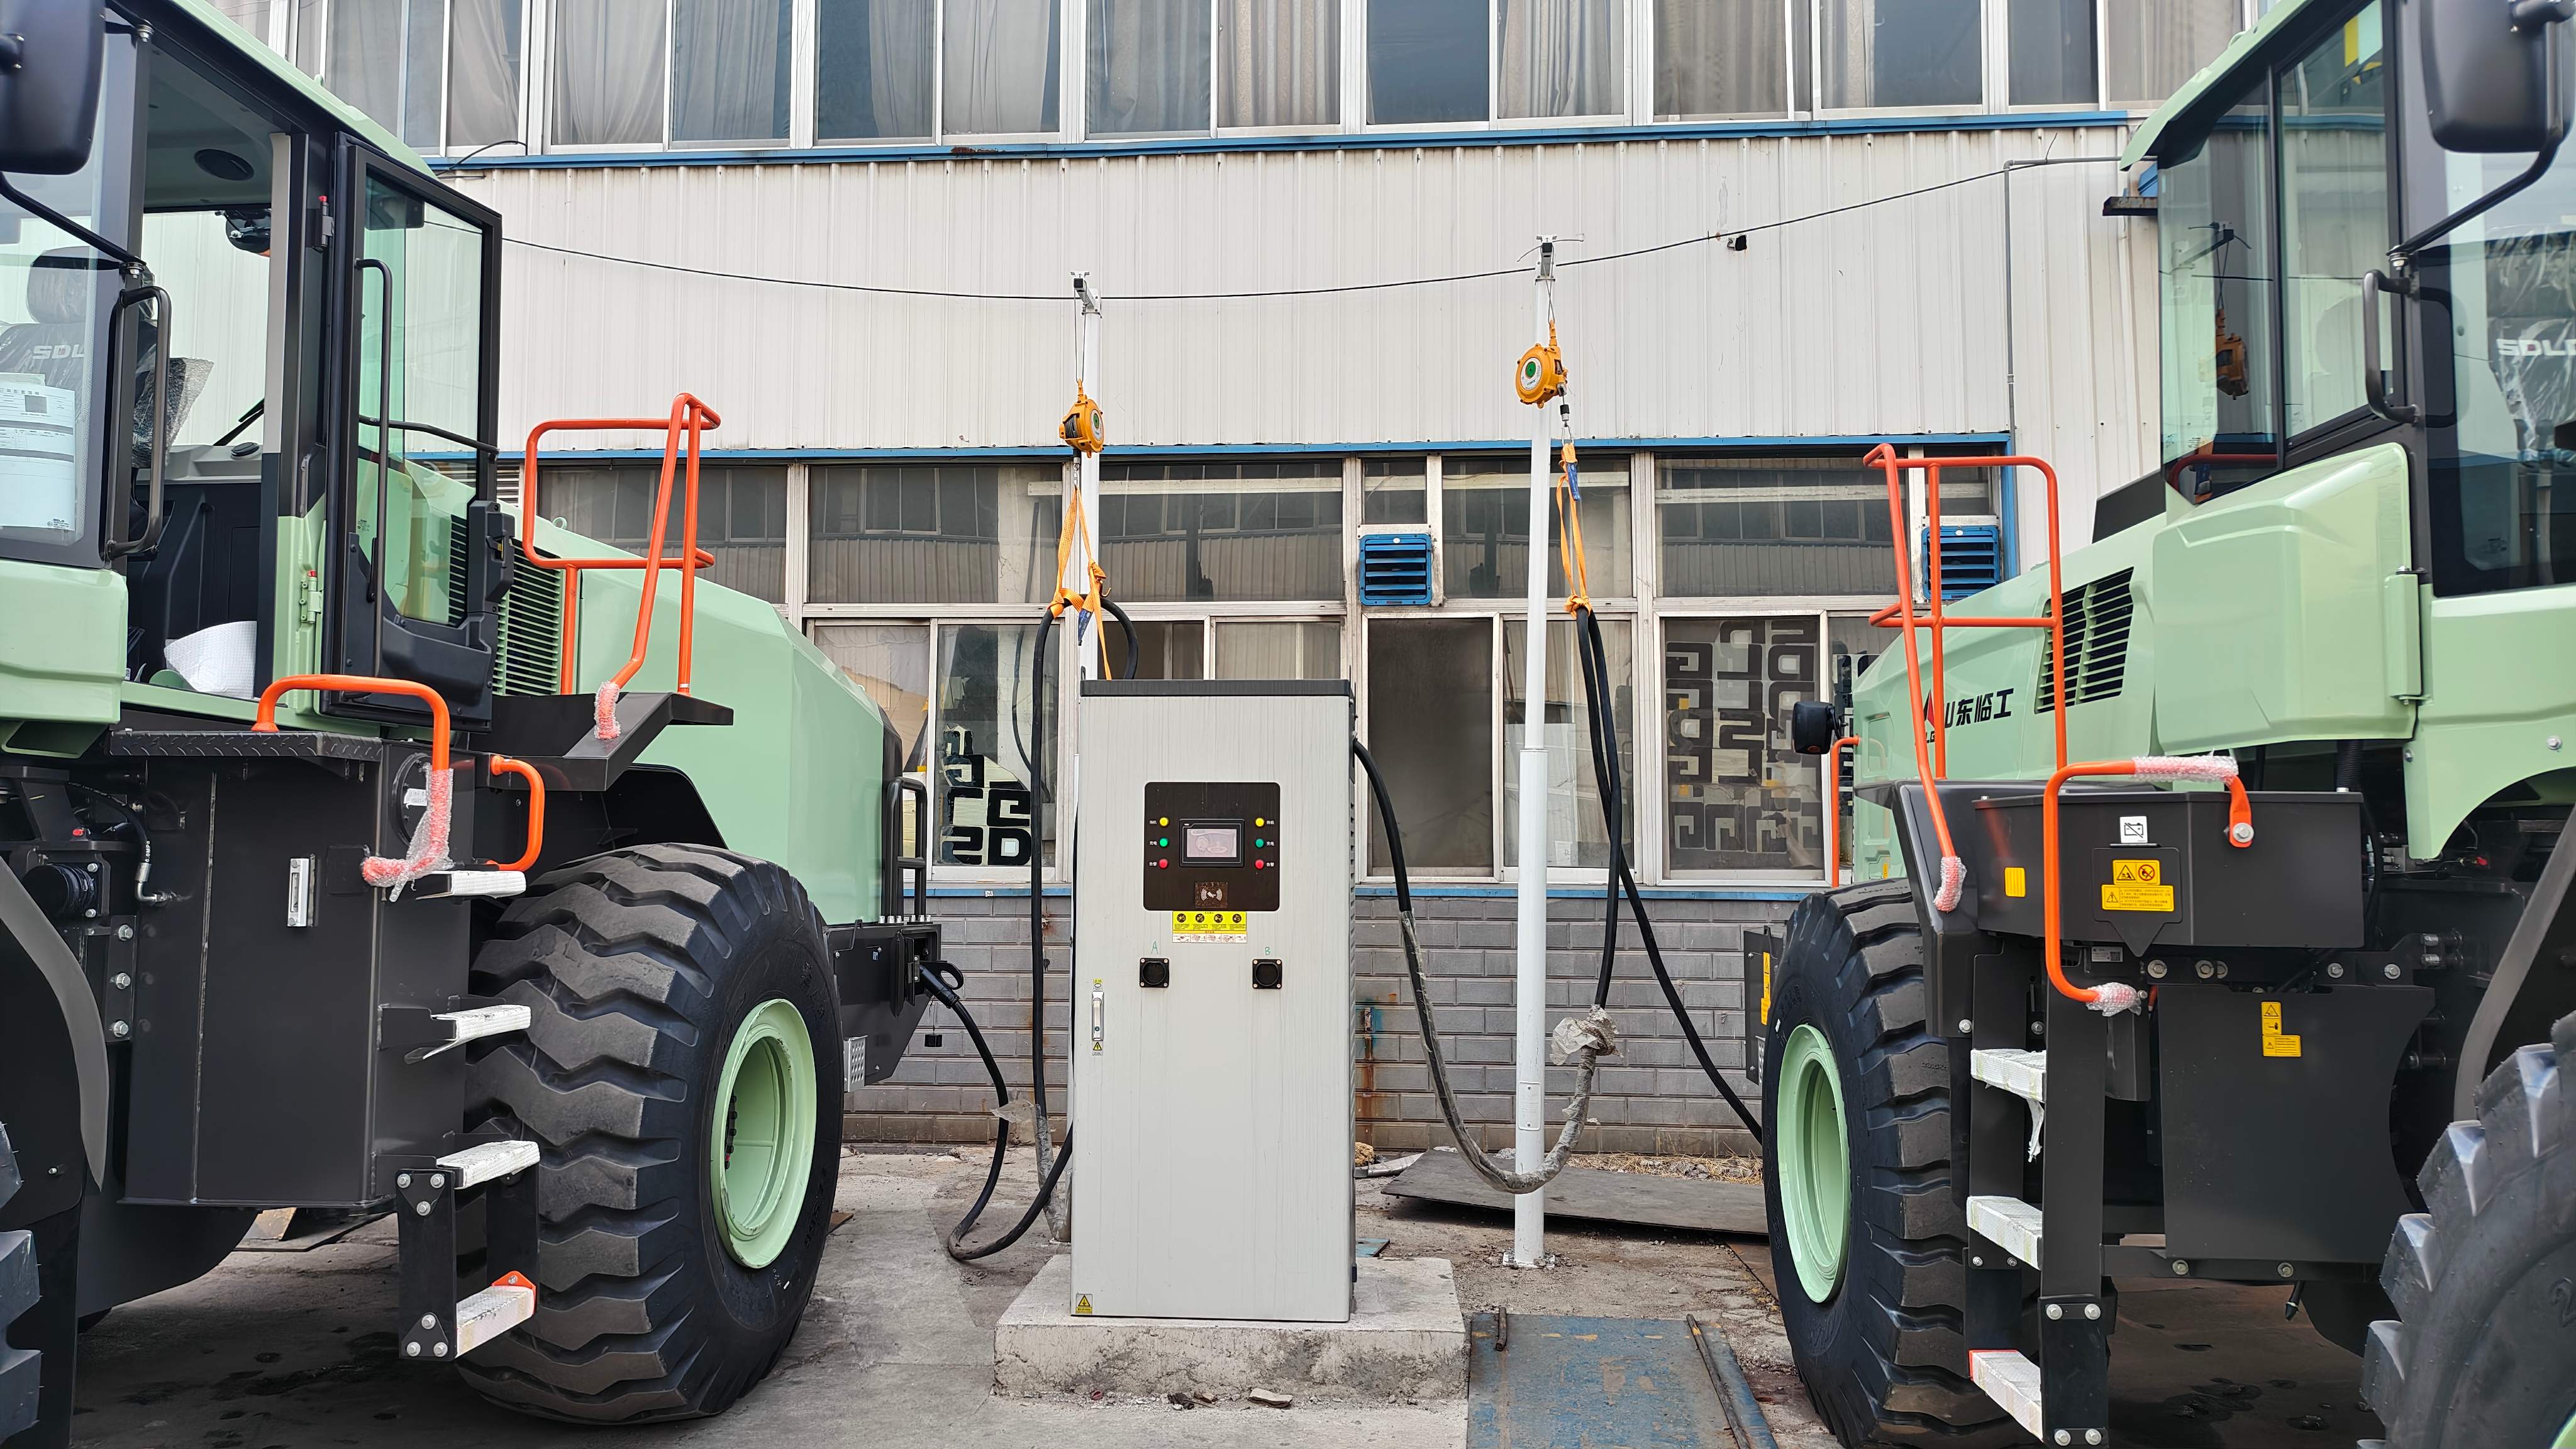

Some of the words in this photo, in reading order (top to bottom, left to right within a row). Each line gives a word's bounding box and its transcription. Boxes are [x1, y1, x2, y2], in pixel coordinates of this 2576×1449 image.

[33, 344, 85, 359] SDL
[1151, 940, 1158, 955] A
[1264, 947, 1270, 955] B
